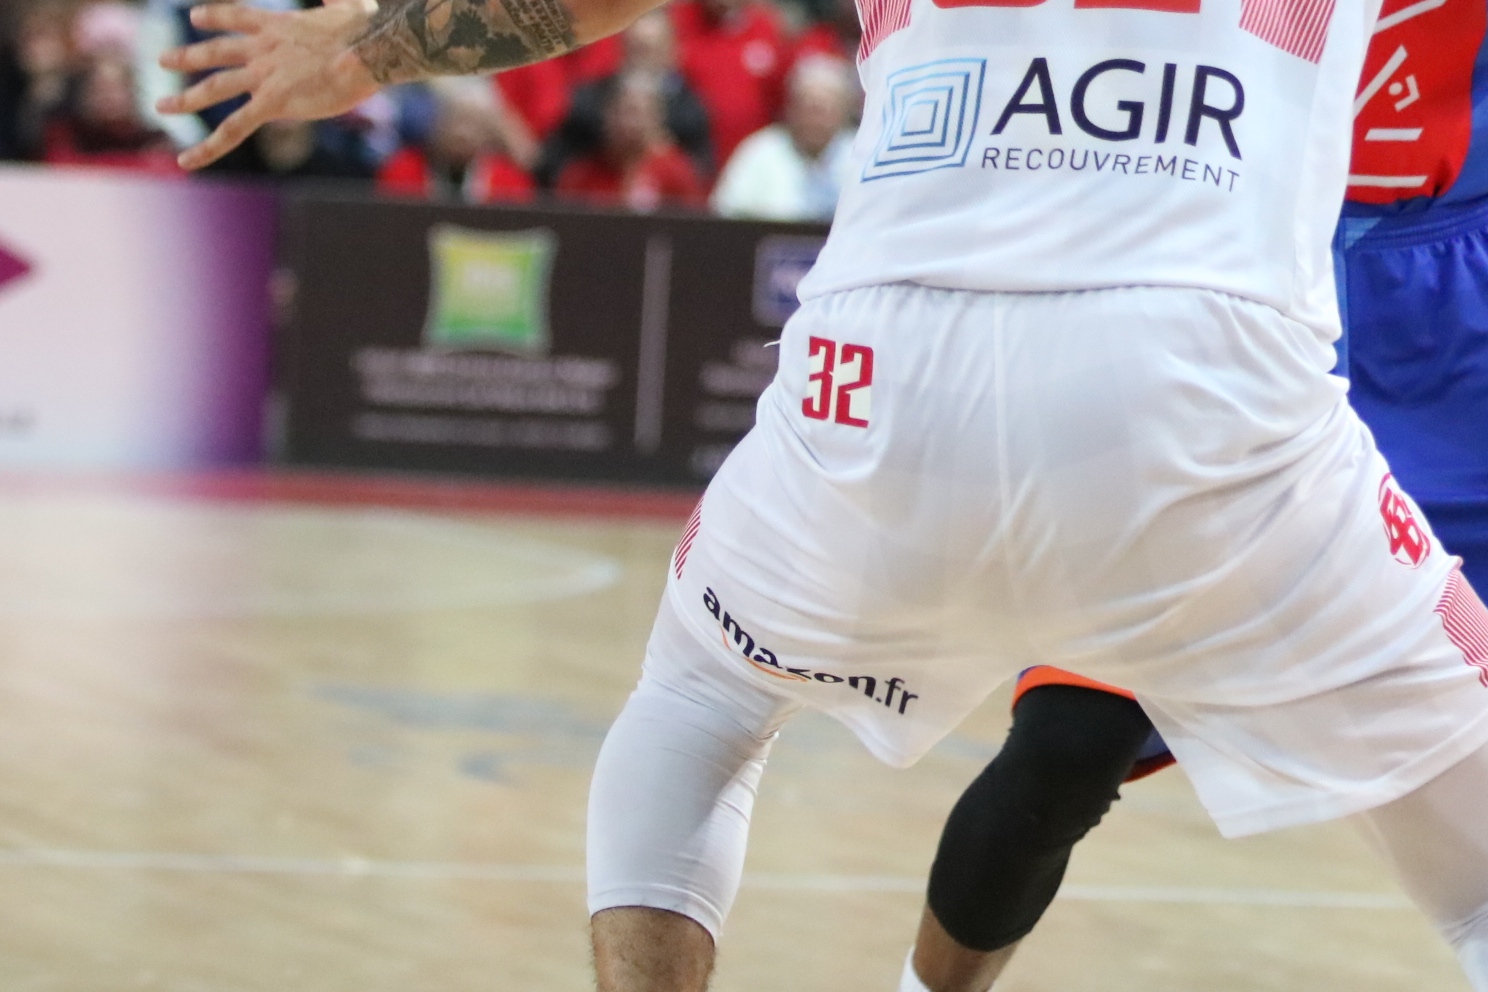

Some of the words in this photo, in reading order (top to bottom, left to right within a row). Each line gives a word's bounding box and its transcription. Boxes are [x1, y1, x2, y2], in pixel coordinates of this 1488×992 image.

[991, 57, 1246, 160] AGIR
[981, 146, 1242, 193] RECOUVREMENT
[801, 335, 875, 429] 32
[702, 586, 919, 715] amazon.fr
